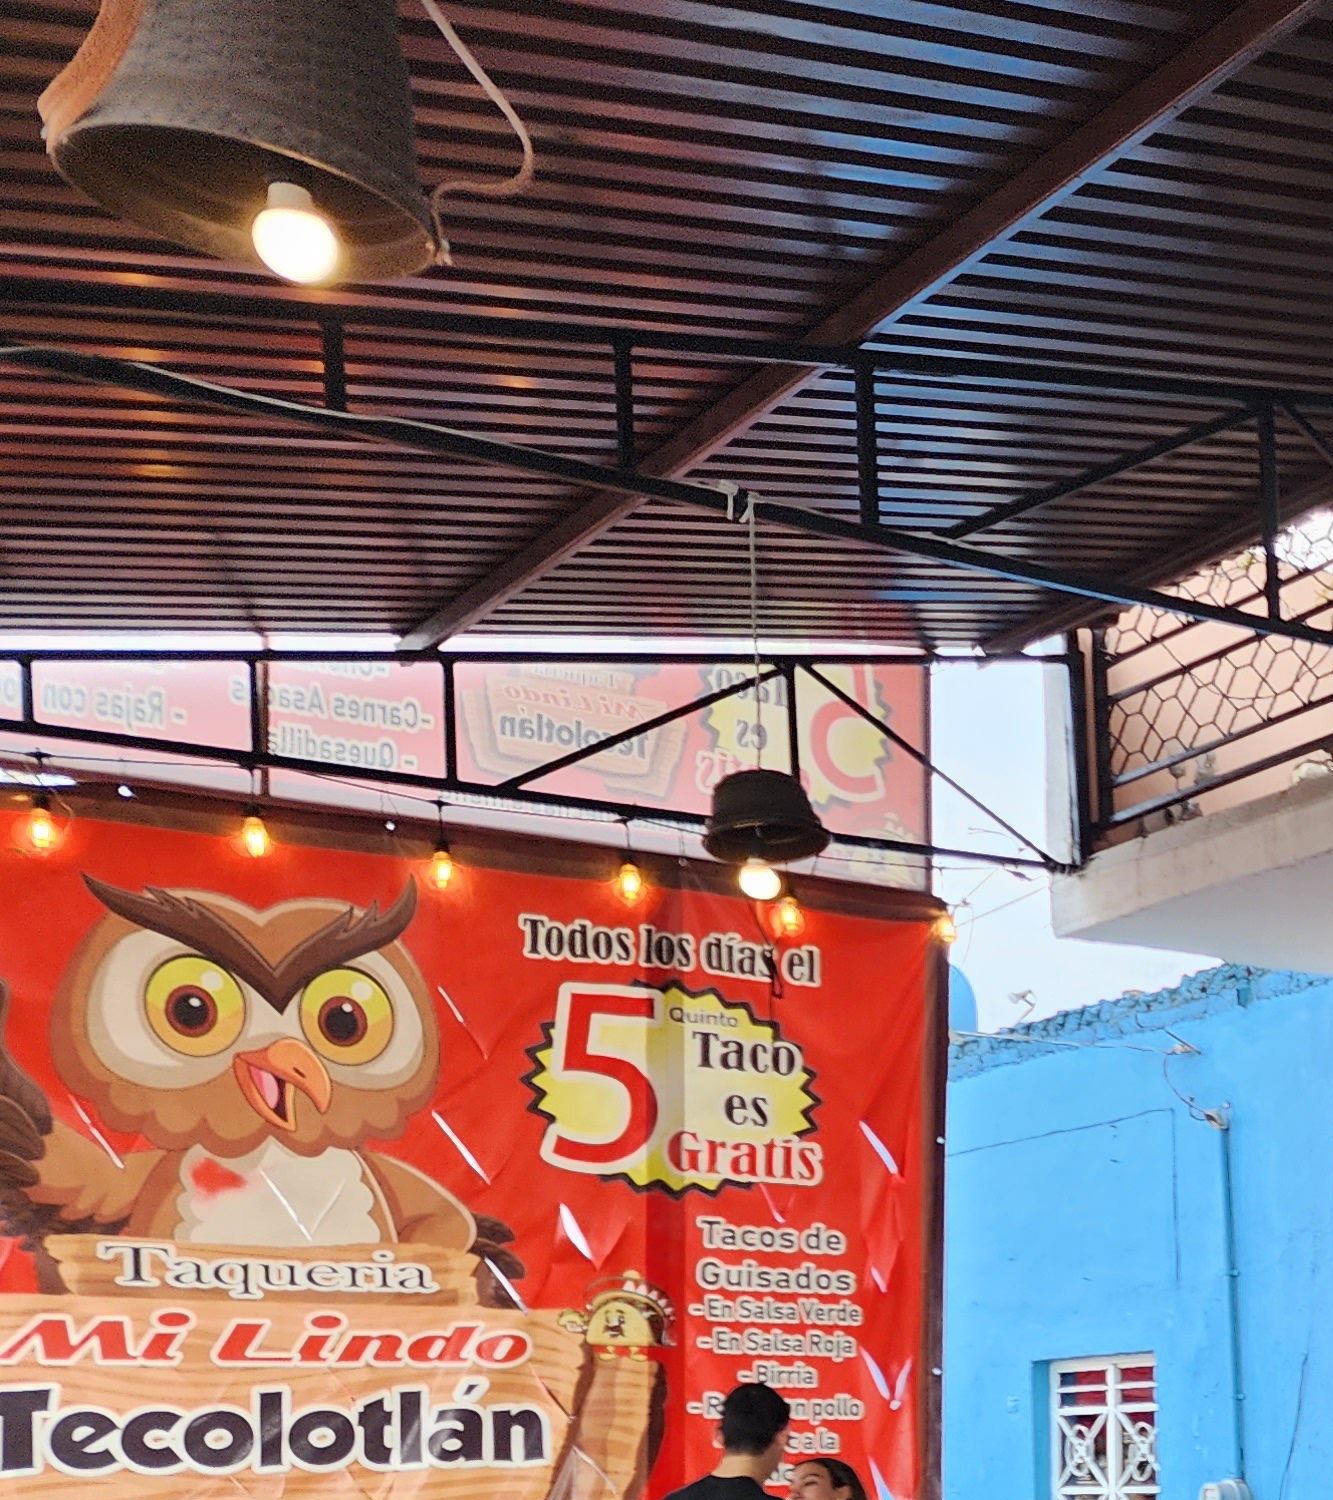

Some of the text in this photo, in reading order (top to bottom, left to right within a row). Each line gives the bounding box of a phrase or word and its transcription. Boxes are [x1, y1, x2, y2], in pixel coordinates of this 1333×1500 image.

[523, 918, 816, 983] Todos los días el
[669, 1006, 738, 1028] Quinto
[692, 1030, 796, 1077] Taco
[552, 992, 658, 1164] 5
[725, 1094, 768, 1127] es
[666, 1131, 817, 1181] Gratis
[700, 1220, 842, 1251] Tacos de
[103, 1246, 435, 1296] Taqueria
[700, 1261, 853, 1292] Guisados
[708, 1299, 733, 1319] En
[738, 1299, 797, 1321] Salsa
[801, 1301, 861, 1323] Verde
[2, 1312, 531, 1364] Mi Lindo
[716, 1331, 740, 1350] En
[746, 1331, 803, 1353] Salsa
[809, 1334, 855, 1358] Roja
[757, 1364, 815, 1385] Birria
[0, 1380, 544, 1471] Tecolotlán
[812, 1396, 861, 1422] pollo
